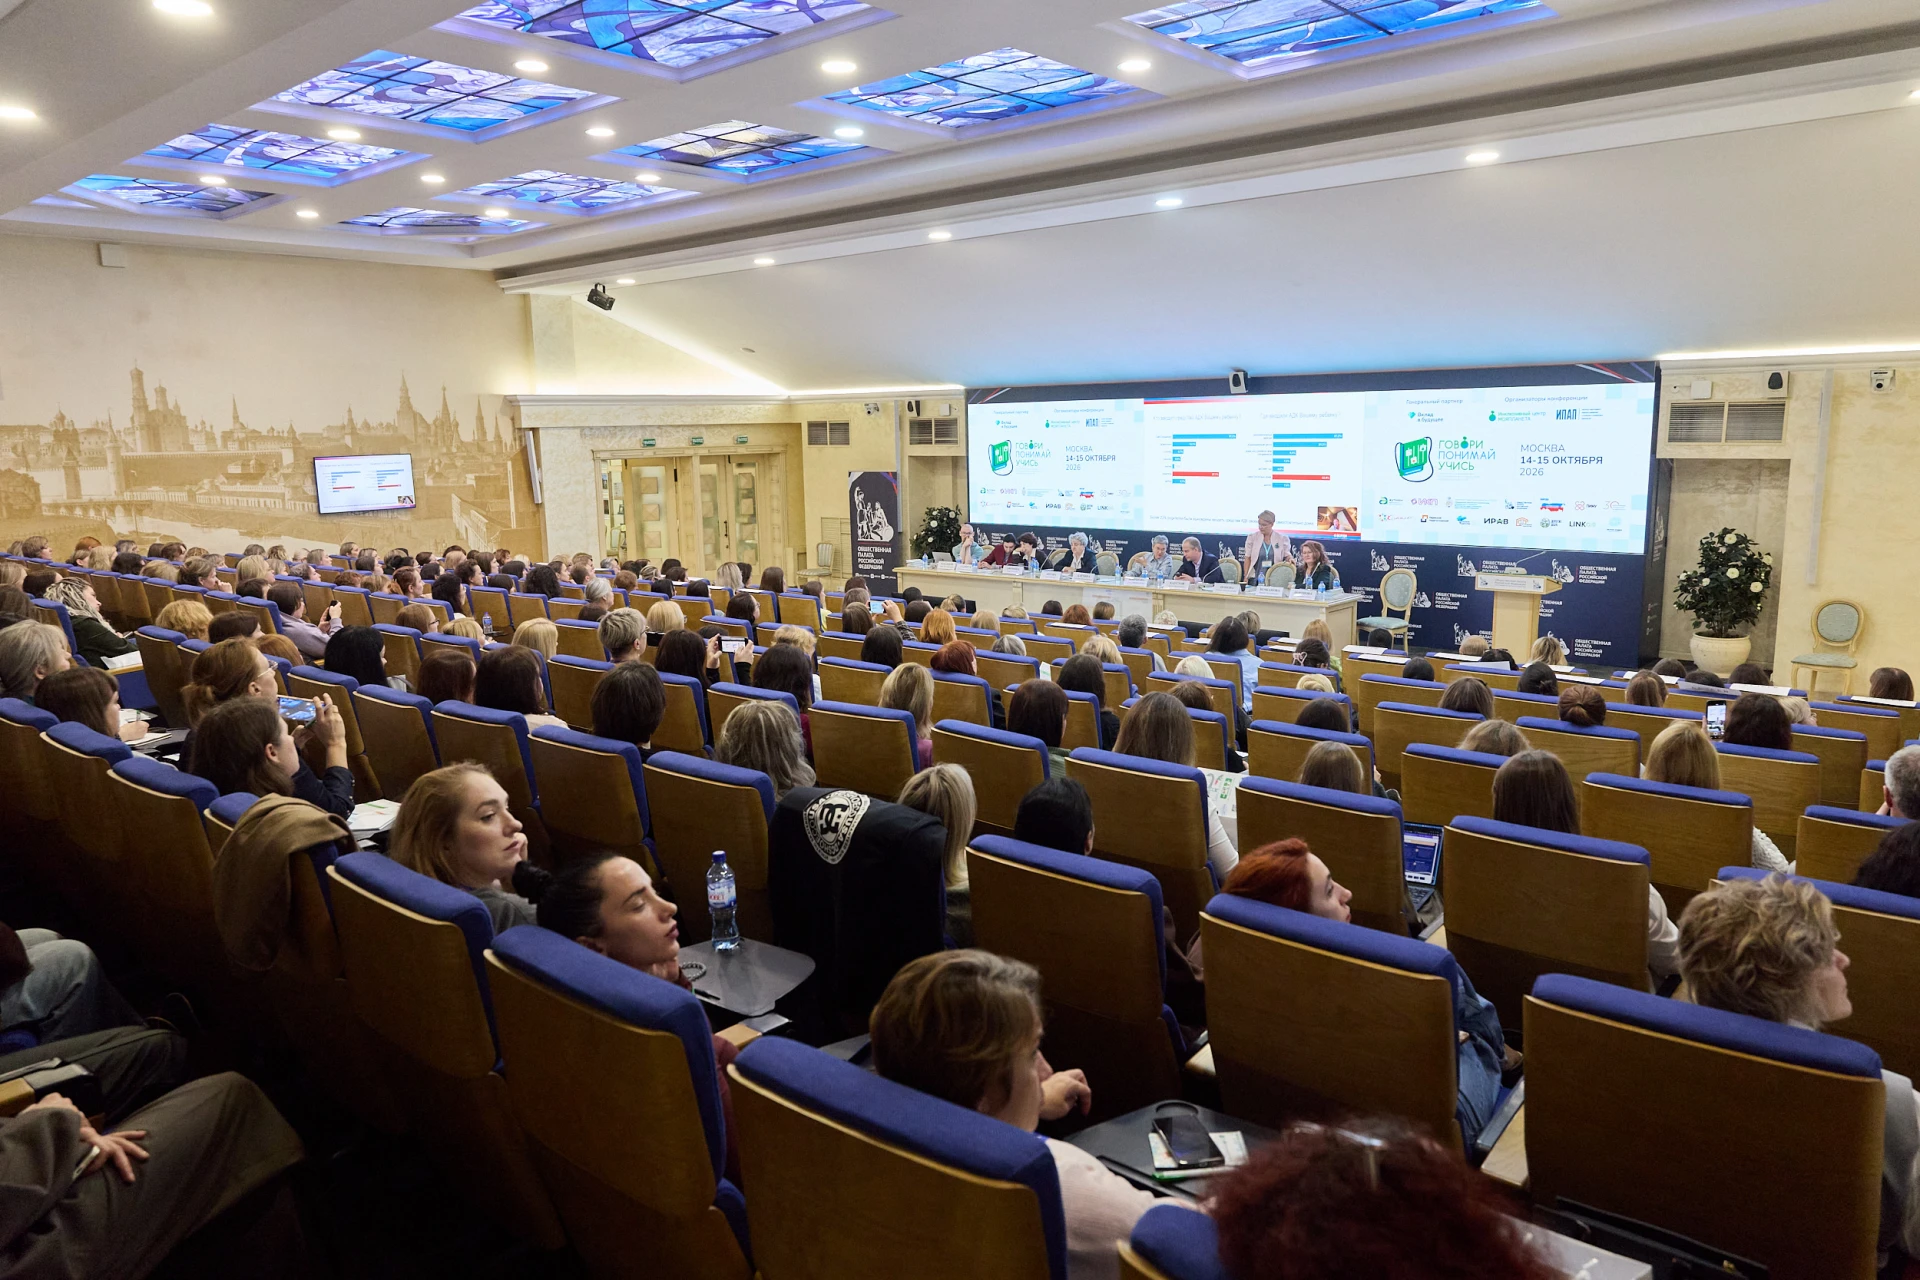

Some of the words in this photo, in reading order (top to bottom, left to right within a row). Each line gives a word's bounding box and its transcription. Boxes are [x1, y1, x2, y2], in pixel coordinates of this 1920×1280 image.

[1438, 439, 1484, 449] ГОВОРИ
[1520, 444, 1566, 453] МОСКВА
[1015, 449, 1051, 458] ПОНИМАЙ
[1065, 445, 1093, 453] МОСКВА
[1438, 449, 1496, 460] ПОНИМАЙ
[1015, 459, 1039, 467] УЧИСЬ
[1520, 456, 1549, 464] 14-15
[1552, 456, 1603, 465] ОКТЯБРЯ
[1438, 461, 1475, 471] УЧИСЬ
[1519, 467, 1544, 476] 2026
[857, 557, 885, 565] РОССИЙСКОЙ
[1574, 638, 1612, 646] ОБЩЕСТВЕННАЯ
